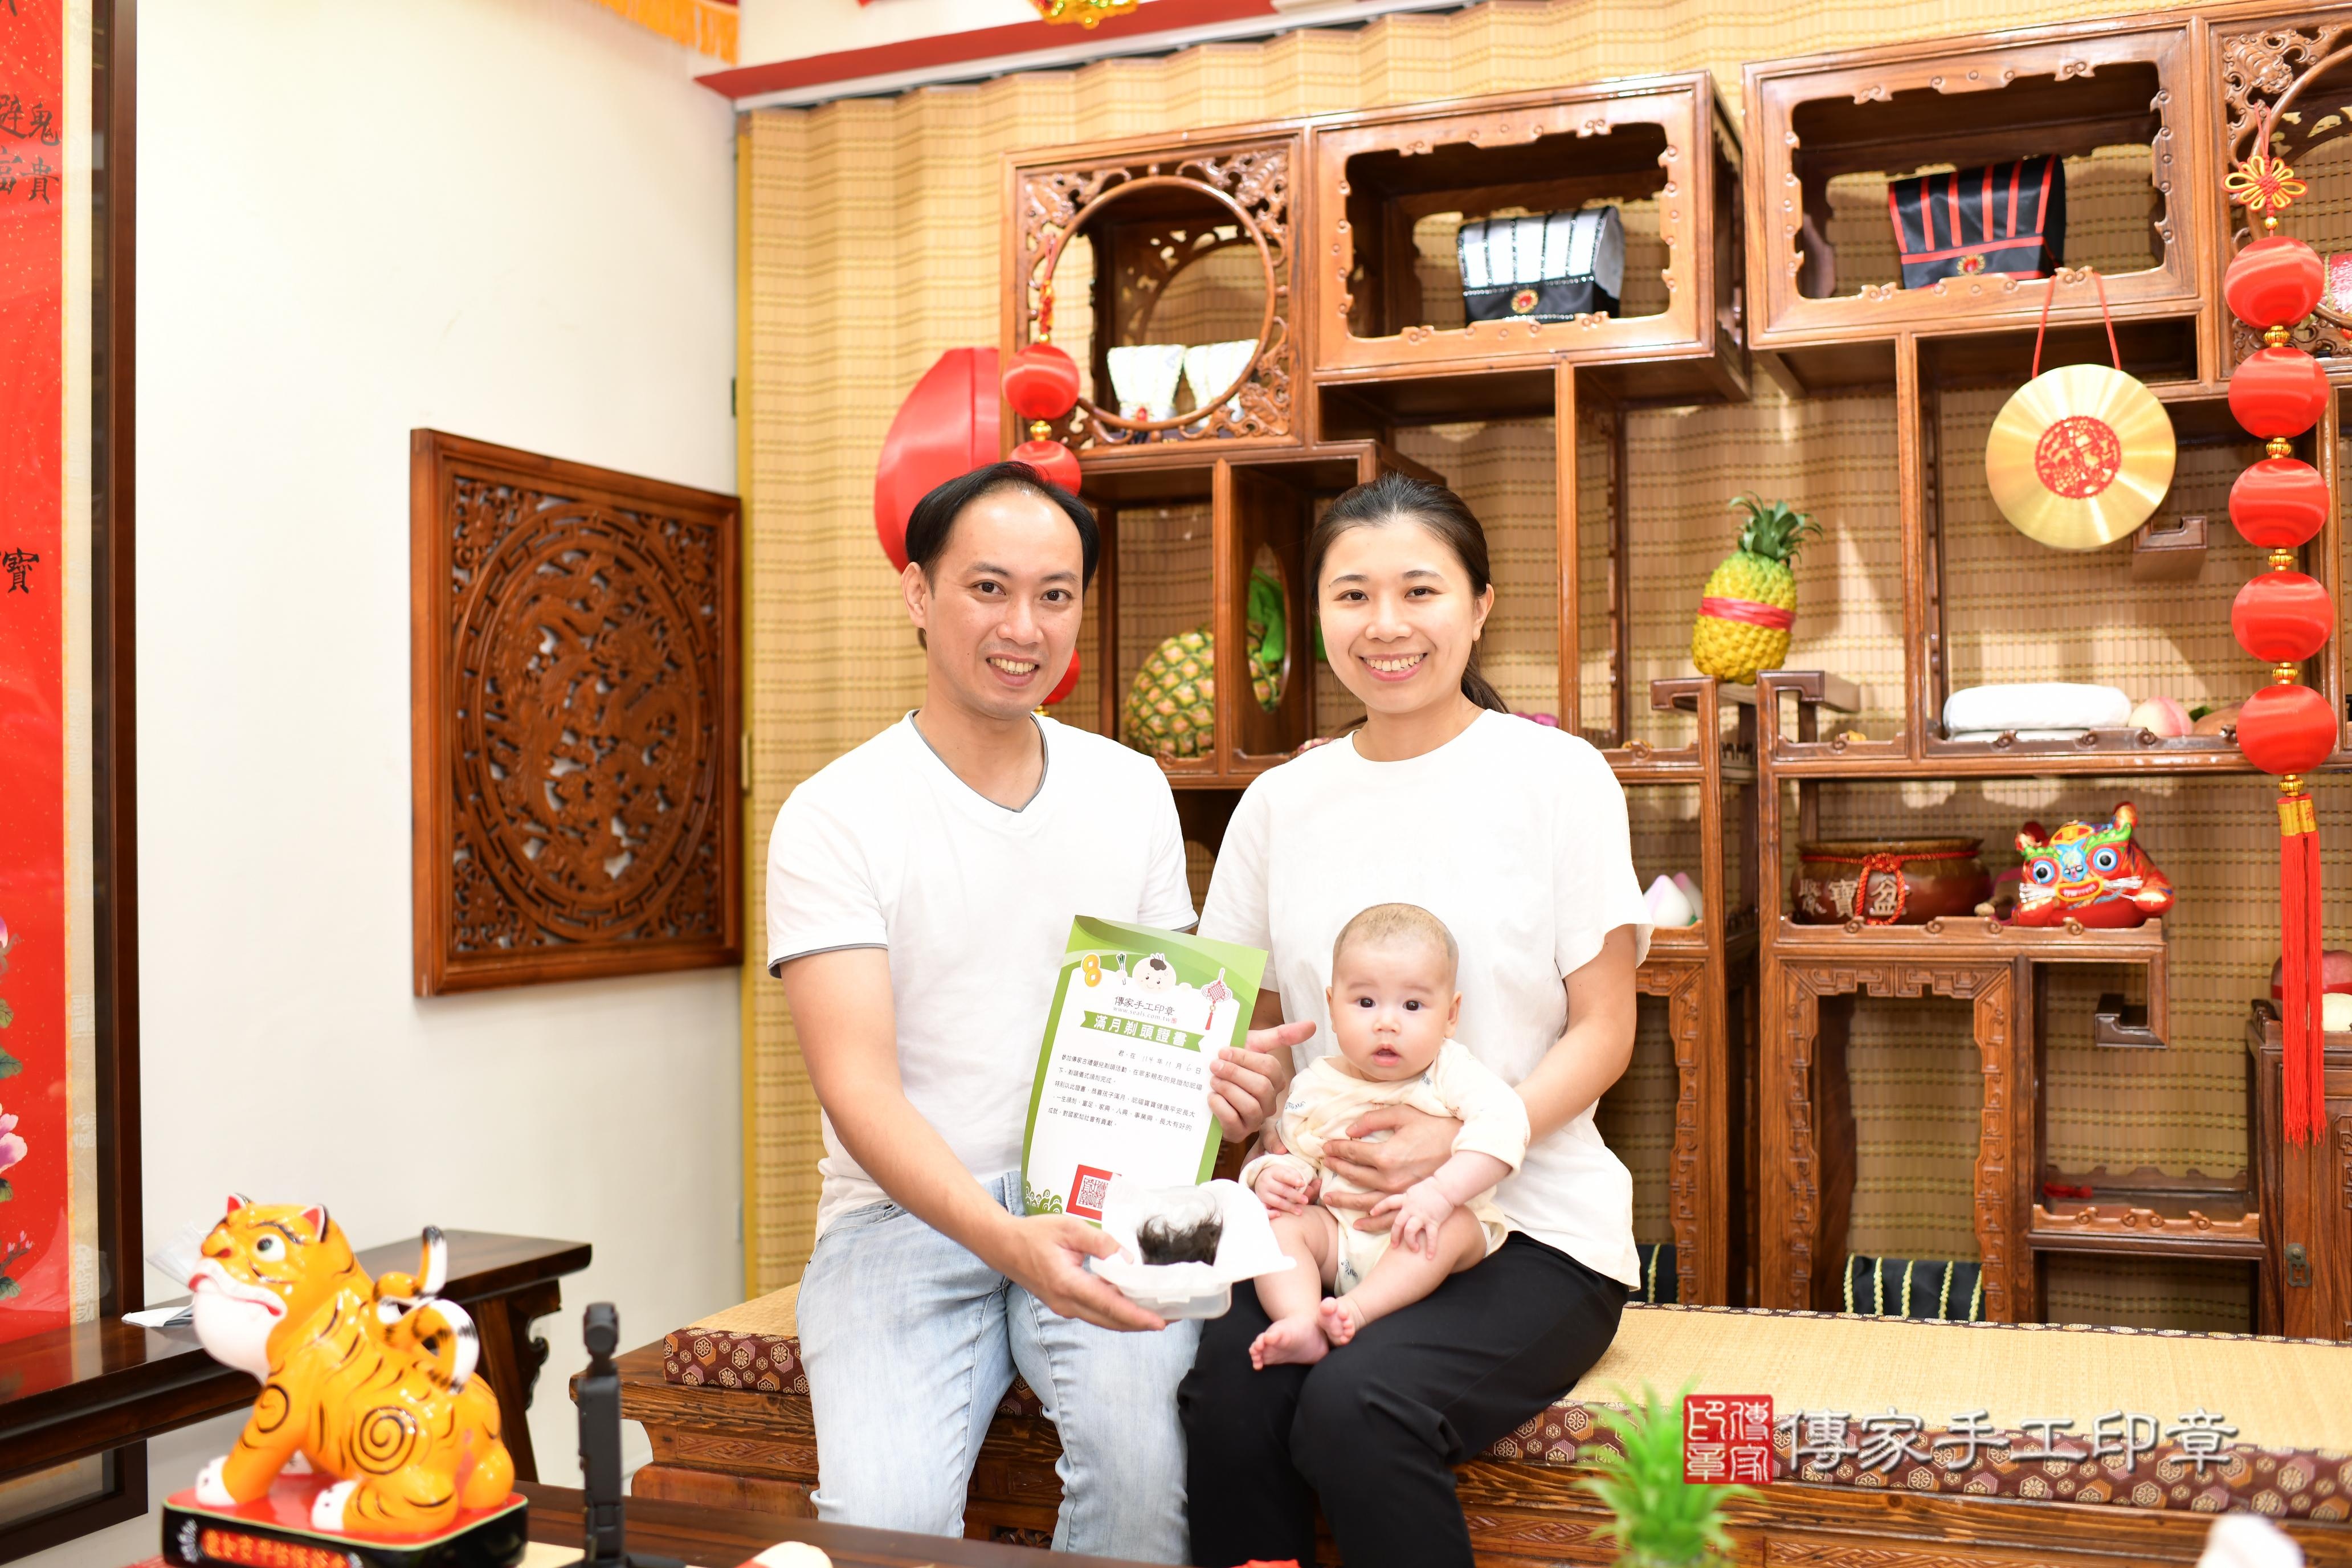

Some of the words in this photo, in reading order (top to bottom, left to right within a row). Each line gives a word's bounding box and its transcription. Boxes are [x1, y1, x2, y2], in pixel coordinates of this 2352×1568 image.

[2, 547, 39, 594] 寶
[1113, 1006, 1170, 1022] www.seals.com.tw
[1115, 996, 1175, 1016] 傳家手工印章
[1094, 1014, 1187, 1047] 滿月剃頭證書
